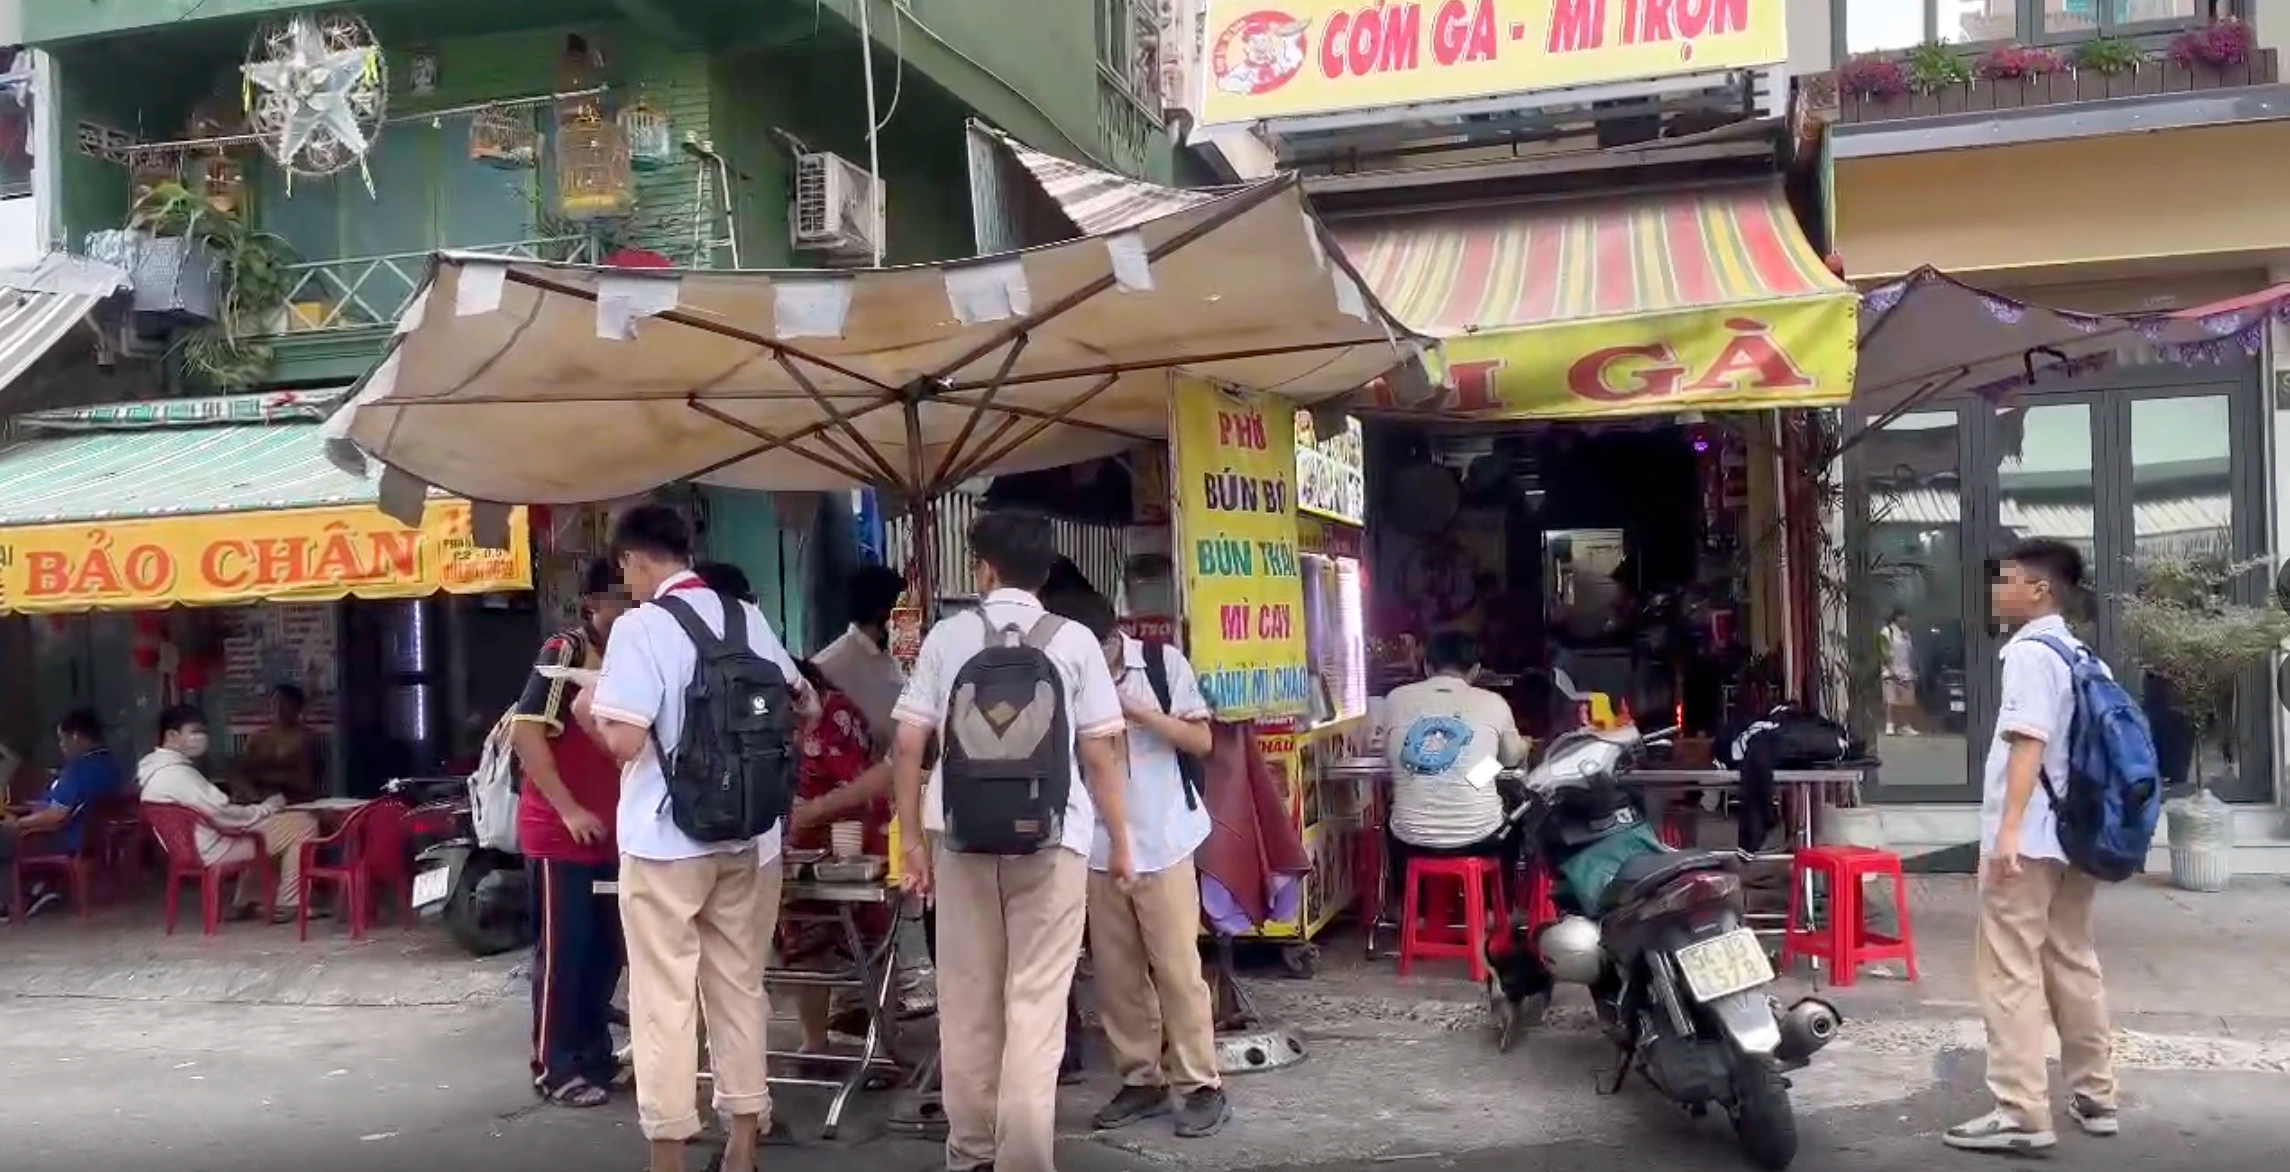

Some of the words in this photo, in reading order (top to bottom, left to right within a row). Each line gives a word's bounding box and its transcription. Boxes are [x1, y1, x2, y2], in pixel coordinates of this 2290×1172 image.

[1568, 317, 1813, 401] GÀ
[1204, 467, 1258, 511] BÚN
[24, 529, 172, 597] BẢO
[200, 520, 424, 588] CHÂN
[1197, 532, 1252, 576] BÚN
[1220, 597, 1250, 641] MÌ
[1257, 604, 1291, 640] CAY
